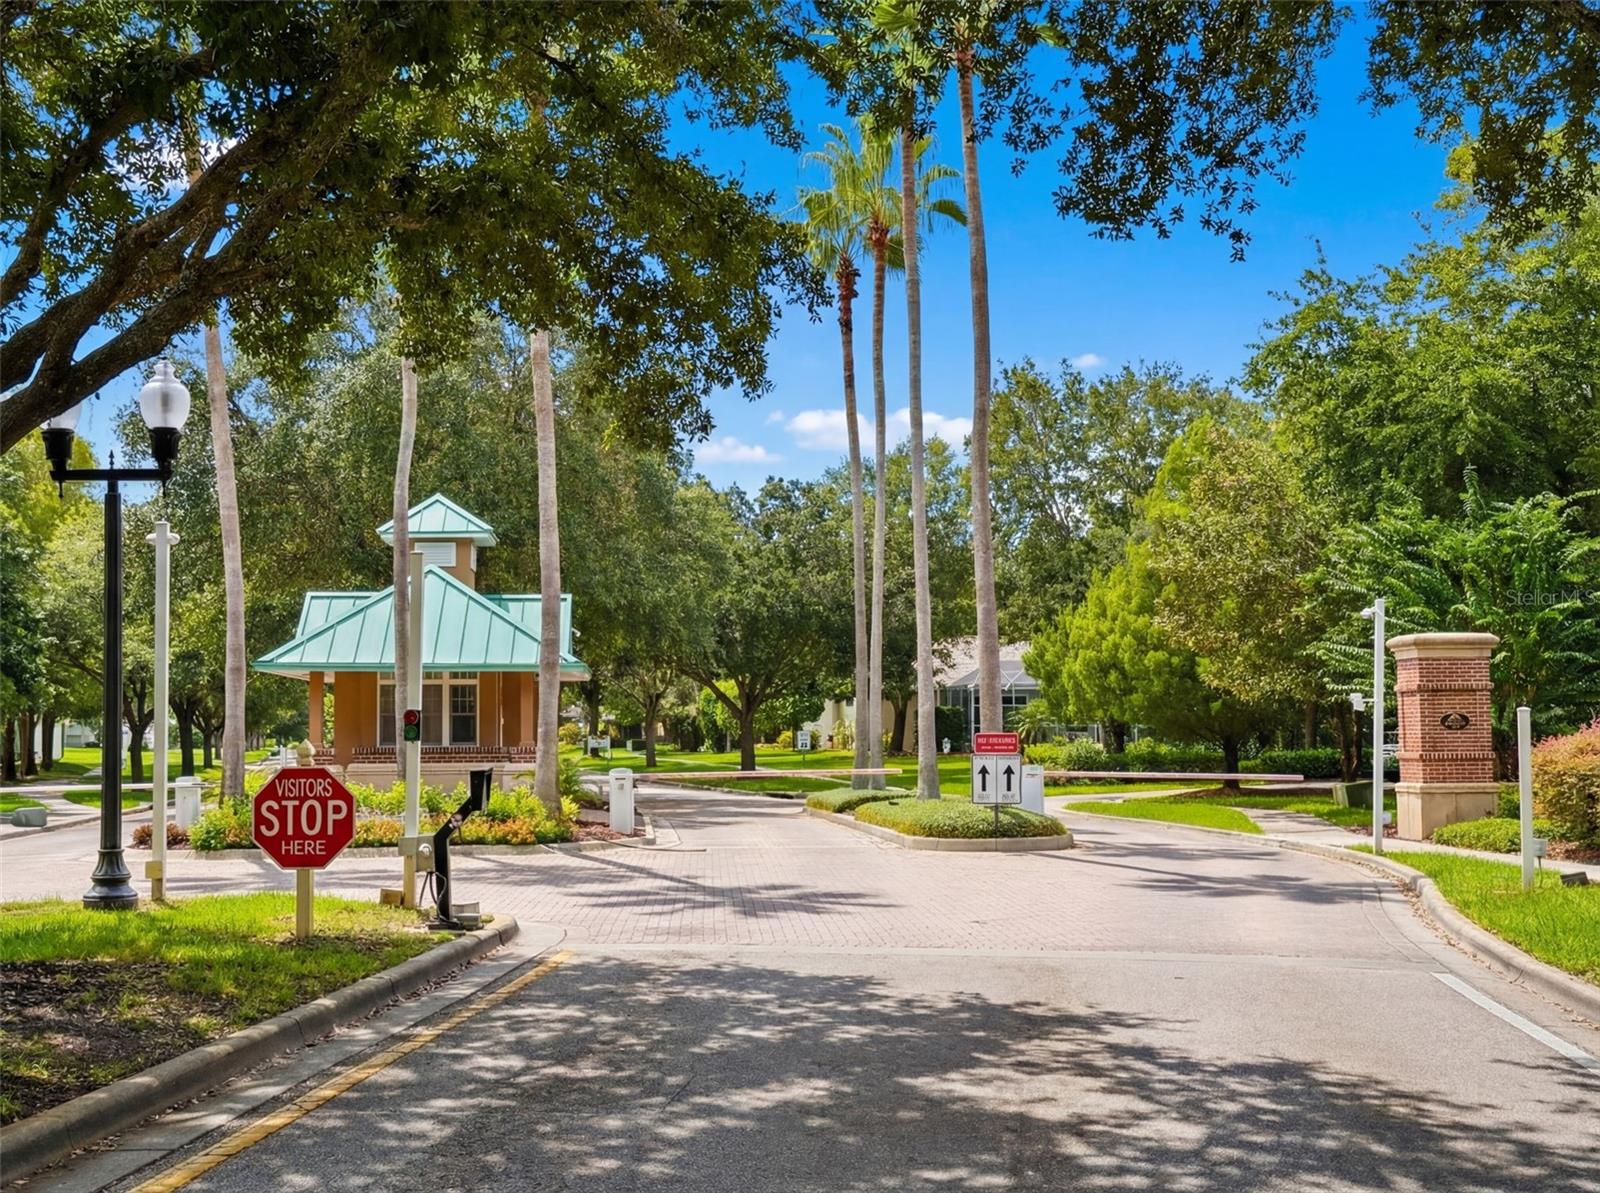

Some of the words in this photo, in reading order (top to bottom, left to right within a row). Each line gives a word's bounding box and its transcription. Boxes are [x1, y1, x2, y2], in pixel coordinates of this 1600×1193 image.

[275, 778, 333, 797] VISITORS
[260, 799, 348, 837] STOP
[281, 840, 327, 855] HERE
